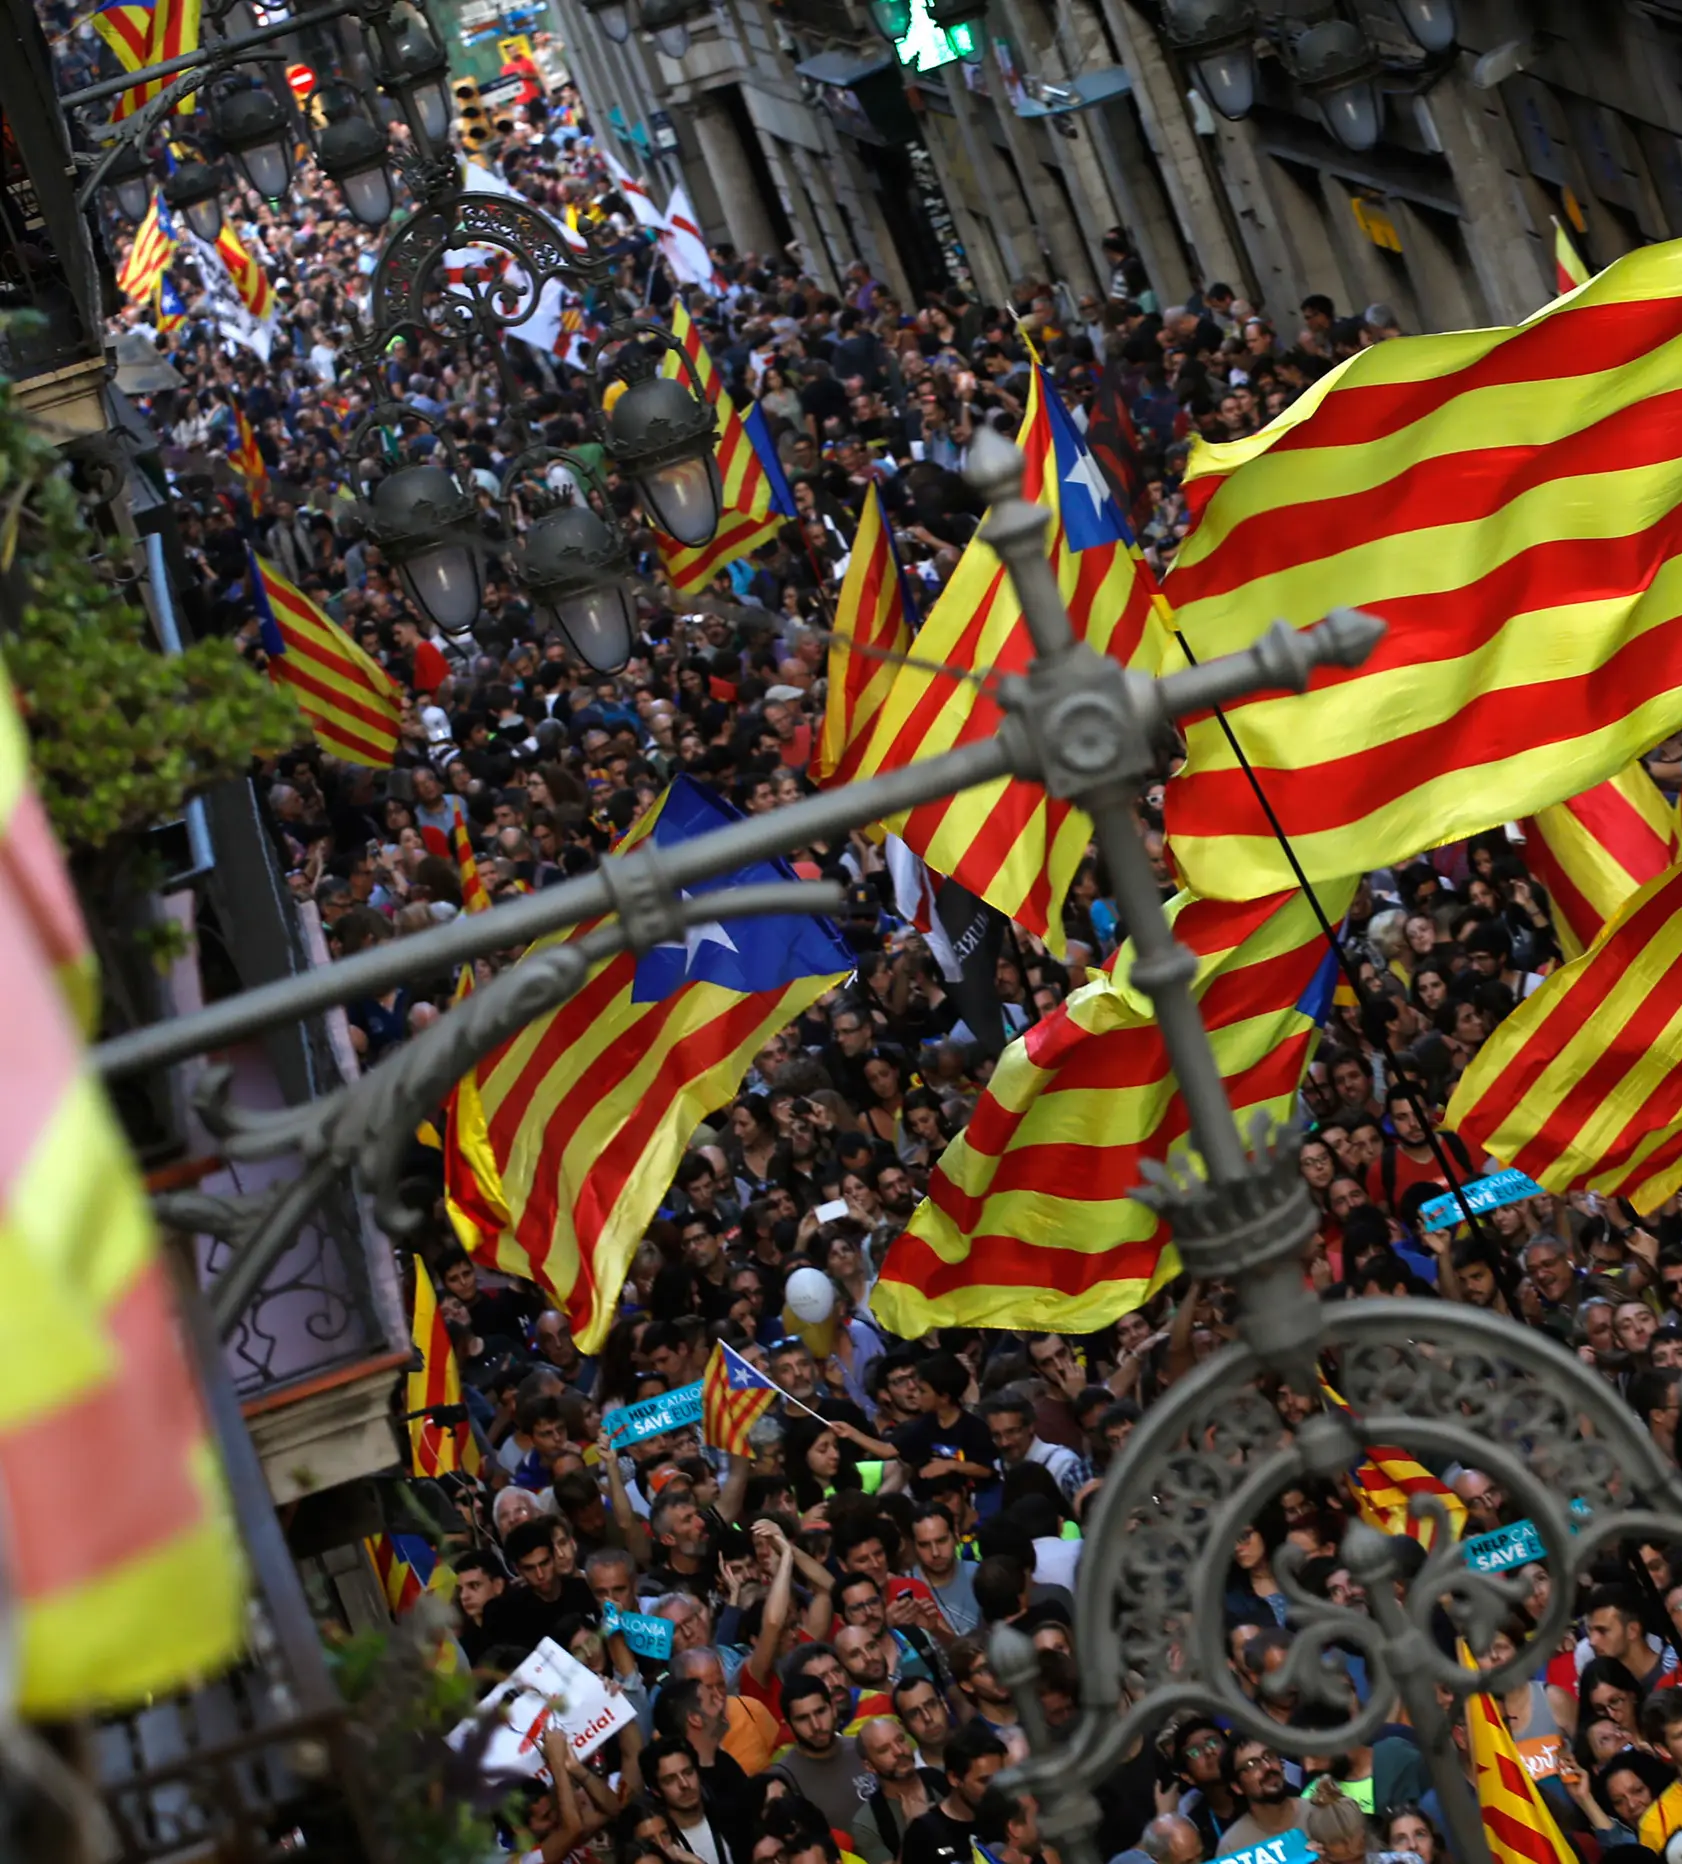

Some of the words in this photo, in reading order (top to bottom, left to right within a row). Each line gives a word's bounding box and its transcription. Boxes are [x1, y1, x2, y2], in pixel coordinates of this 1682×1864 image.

[628, 1403, 657, 1421] HELP
[633, 1411, 674, 1435] SAVE
[671, 1400, 703, 1421] EUR
[1469, 1533, 1508, 1556] HELP
[1476, 1542, 1528, 1571] SAVE
[1220, 1840, 1288, 1864] TAT
